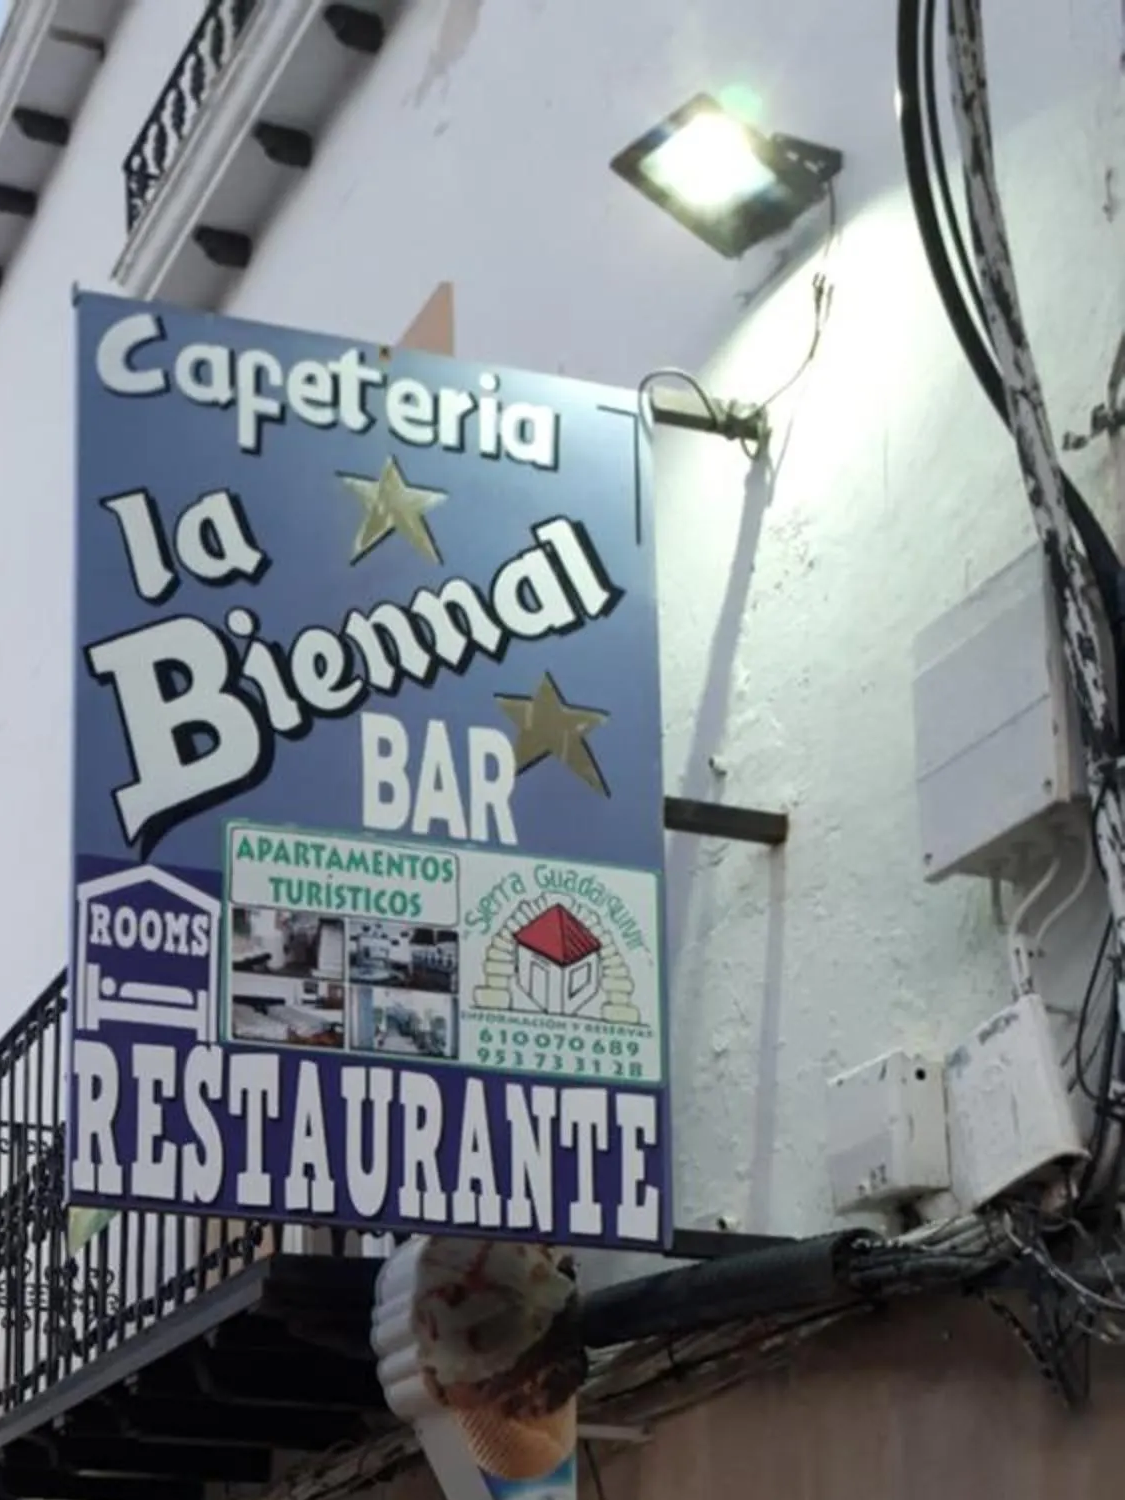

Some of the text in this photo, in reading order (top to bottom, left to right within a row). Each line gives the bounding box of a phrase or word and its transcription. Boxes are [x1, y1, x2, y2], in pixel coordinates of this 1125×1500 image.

[95, 312, 558, 469] Cafeteria
[100, 487, 271, 601] la
[85, 515, 625, 860] Biennal
[360, 711, 517, 845] BAR
[236, 835, 454, 883] APARTAMENTOS
[269, 873, 422, 917] TURÍSTICOS
[89, 902, 211, 957] ROOMS
[72, 1039, 660, 1243] RESTAURANTE
